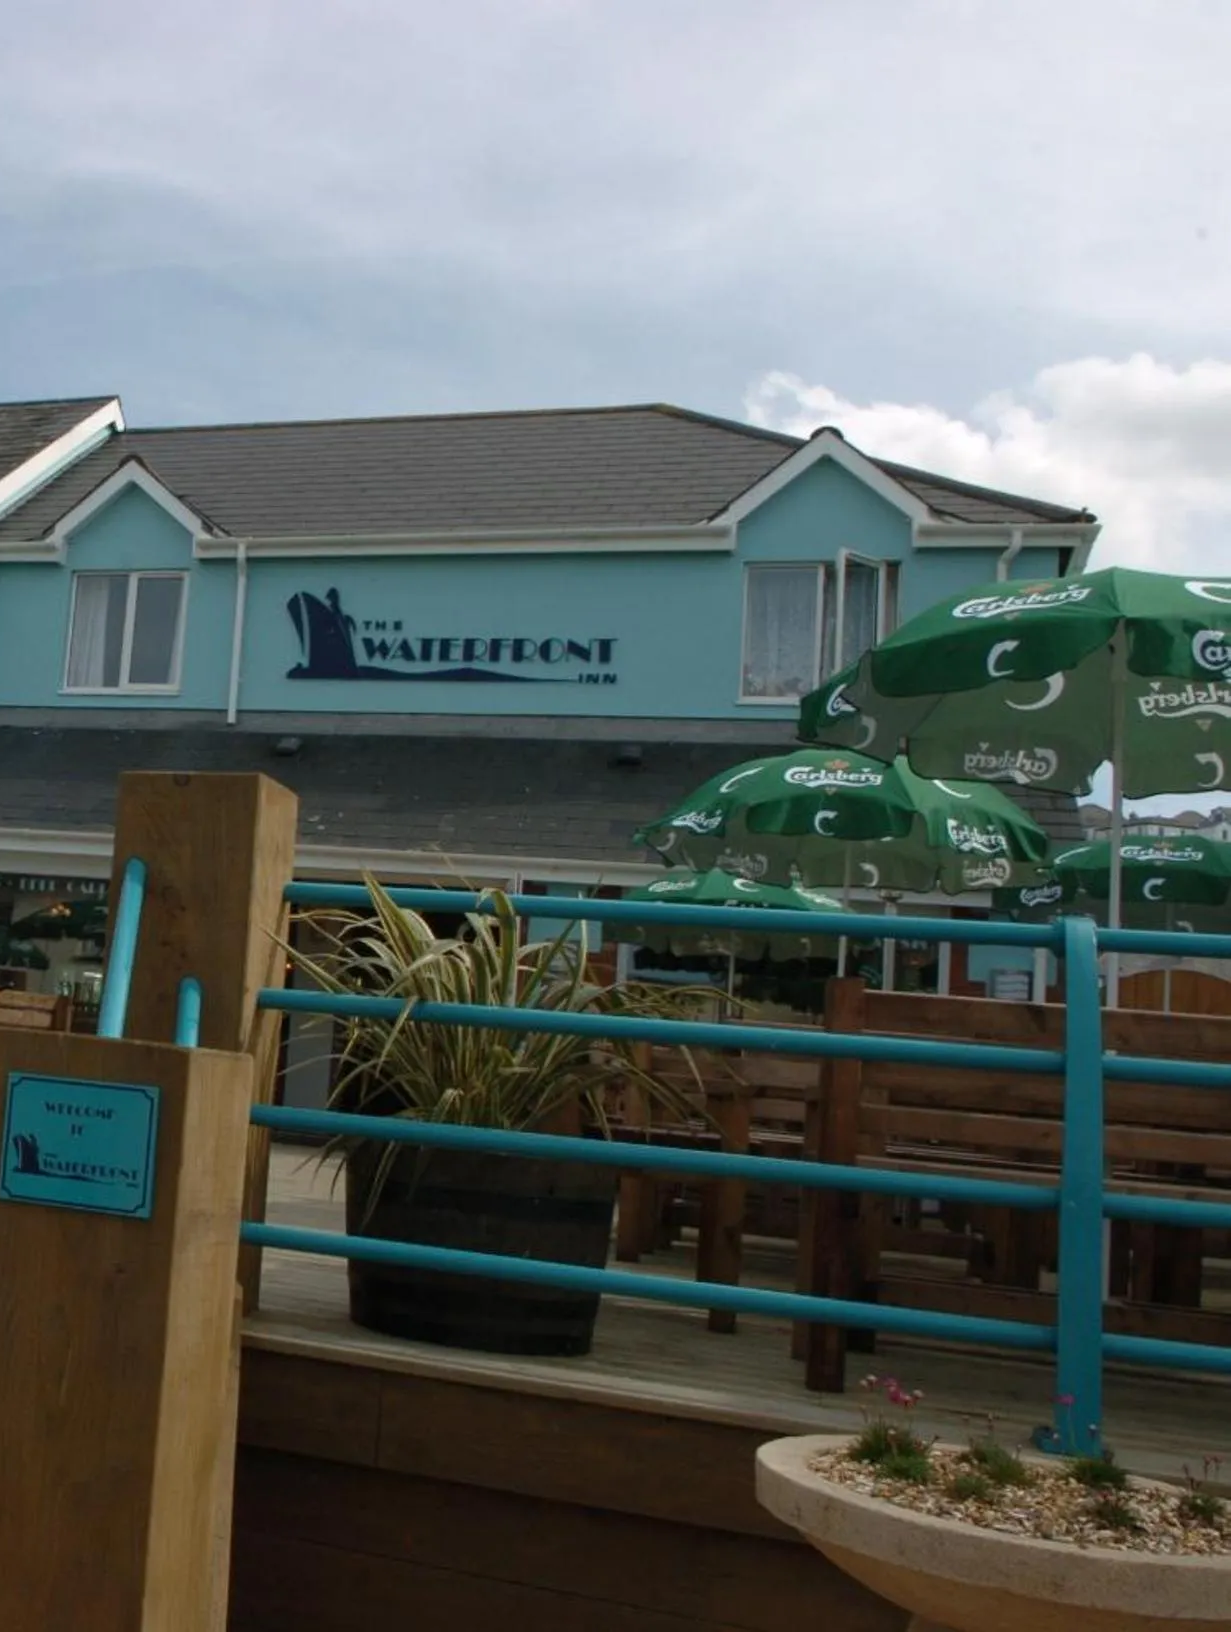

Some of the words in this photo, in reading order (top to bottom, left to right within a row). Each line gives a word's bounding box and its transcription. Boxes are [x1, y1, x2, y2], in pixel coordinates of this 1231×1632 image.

[953, 583, 1093, 618] Carlsberg
[363, 620, 403, 631] THE
[361, 637, 618, 664] WATERFRONT
[578, 673, 617, 684] INN
[784, 766, 883, 788] Carlsberg
[1120, 845, 1204, 861] Carlsberg
